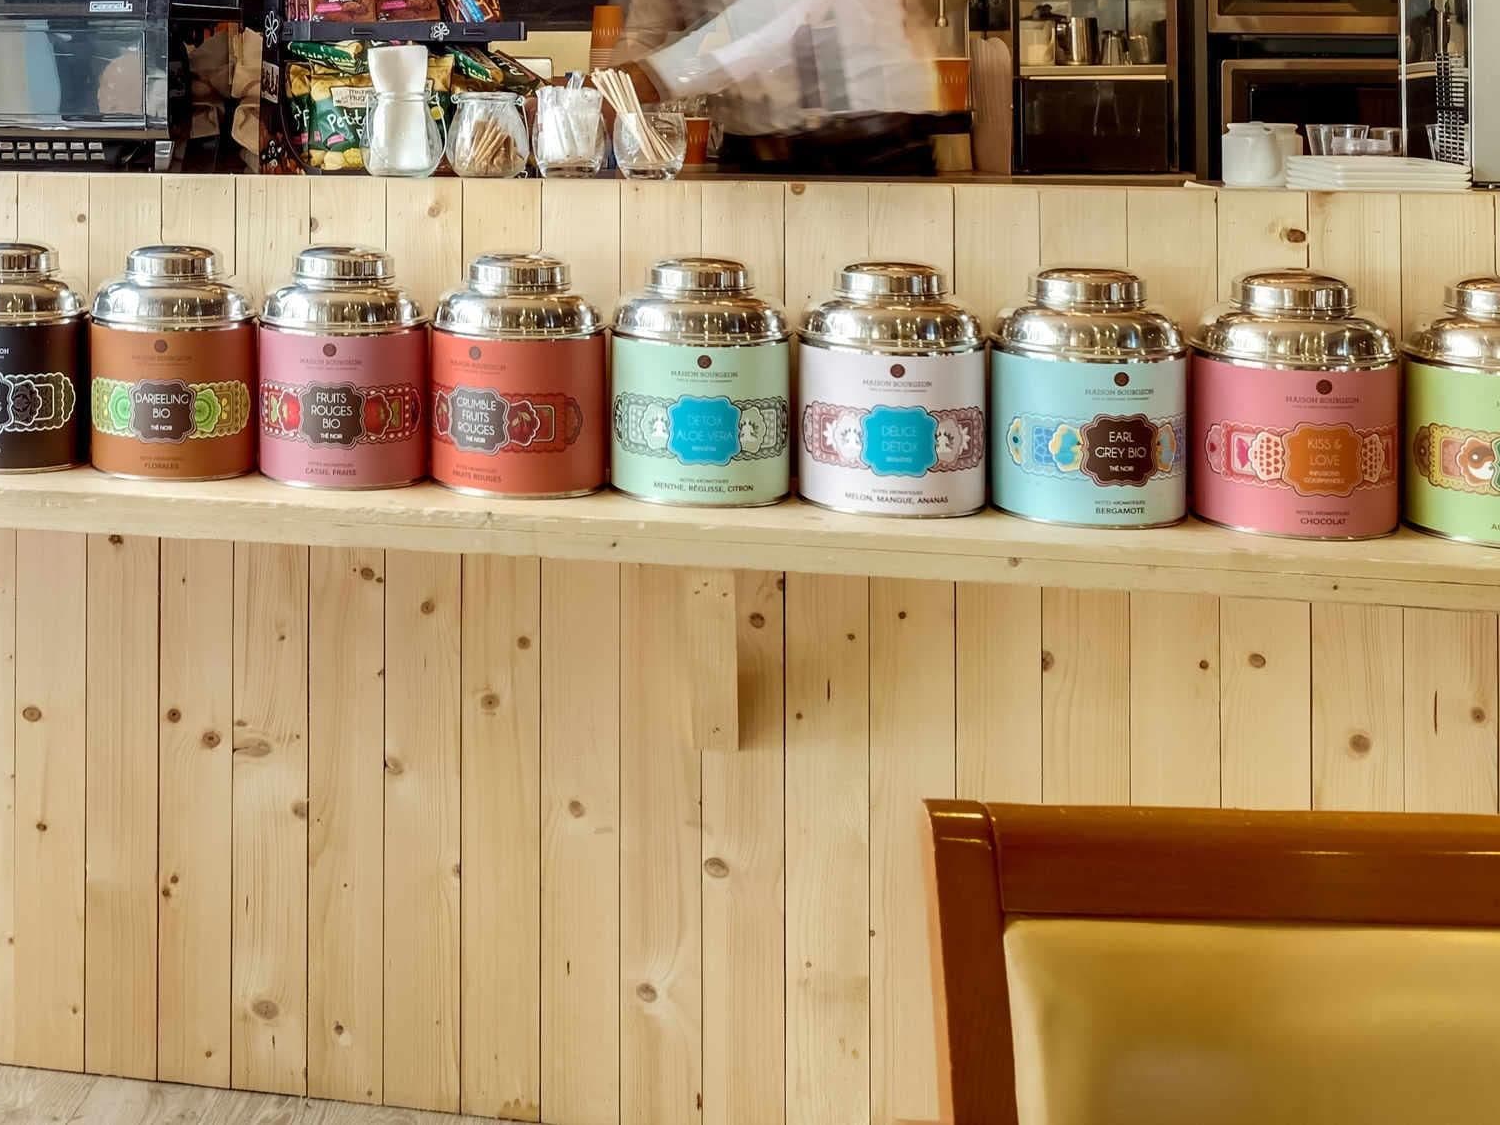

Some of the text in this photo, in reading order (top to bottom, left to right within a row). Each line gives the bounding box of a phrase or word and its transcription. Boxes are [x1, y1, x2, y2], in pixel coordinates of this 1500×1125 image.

[136, 393, 189, 405] DARJEELING
[316, 392, 347, 403] FRUITS
[456, 396, 497, 411] CRUMBLE
[152, 408, 171, 419] BIO
[310, 405, 353, 417] ROUGES
[461, 409, 490, 423] FRUITS
[322, 418, 341, 429] BIO
[457, 421, 495, 436] ROUGES
[1109, 431, 1136, 443] EARL
[1307, 437, 1331, 450] KISS
[1094, 446, 1147, 459] GREY BIO
[1309, 454, 1341, 467] LOVE
[1095, 506, 1147, 515] BERGAMOTE
